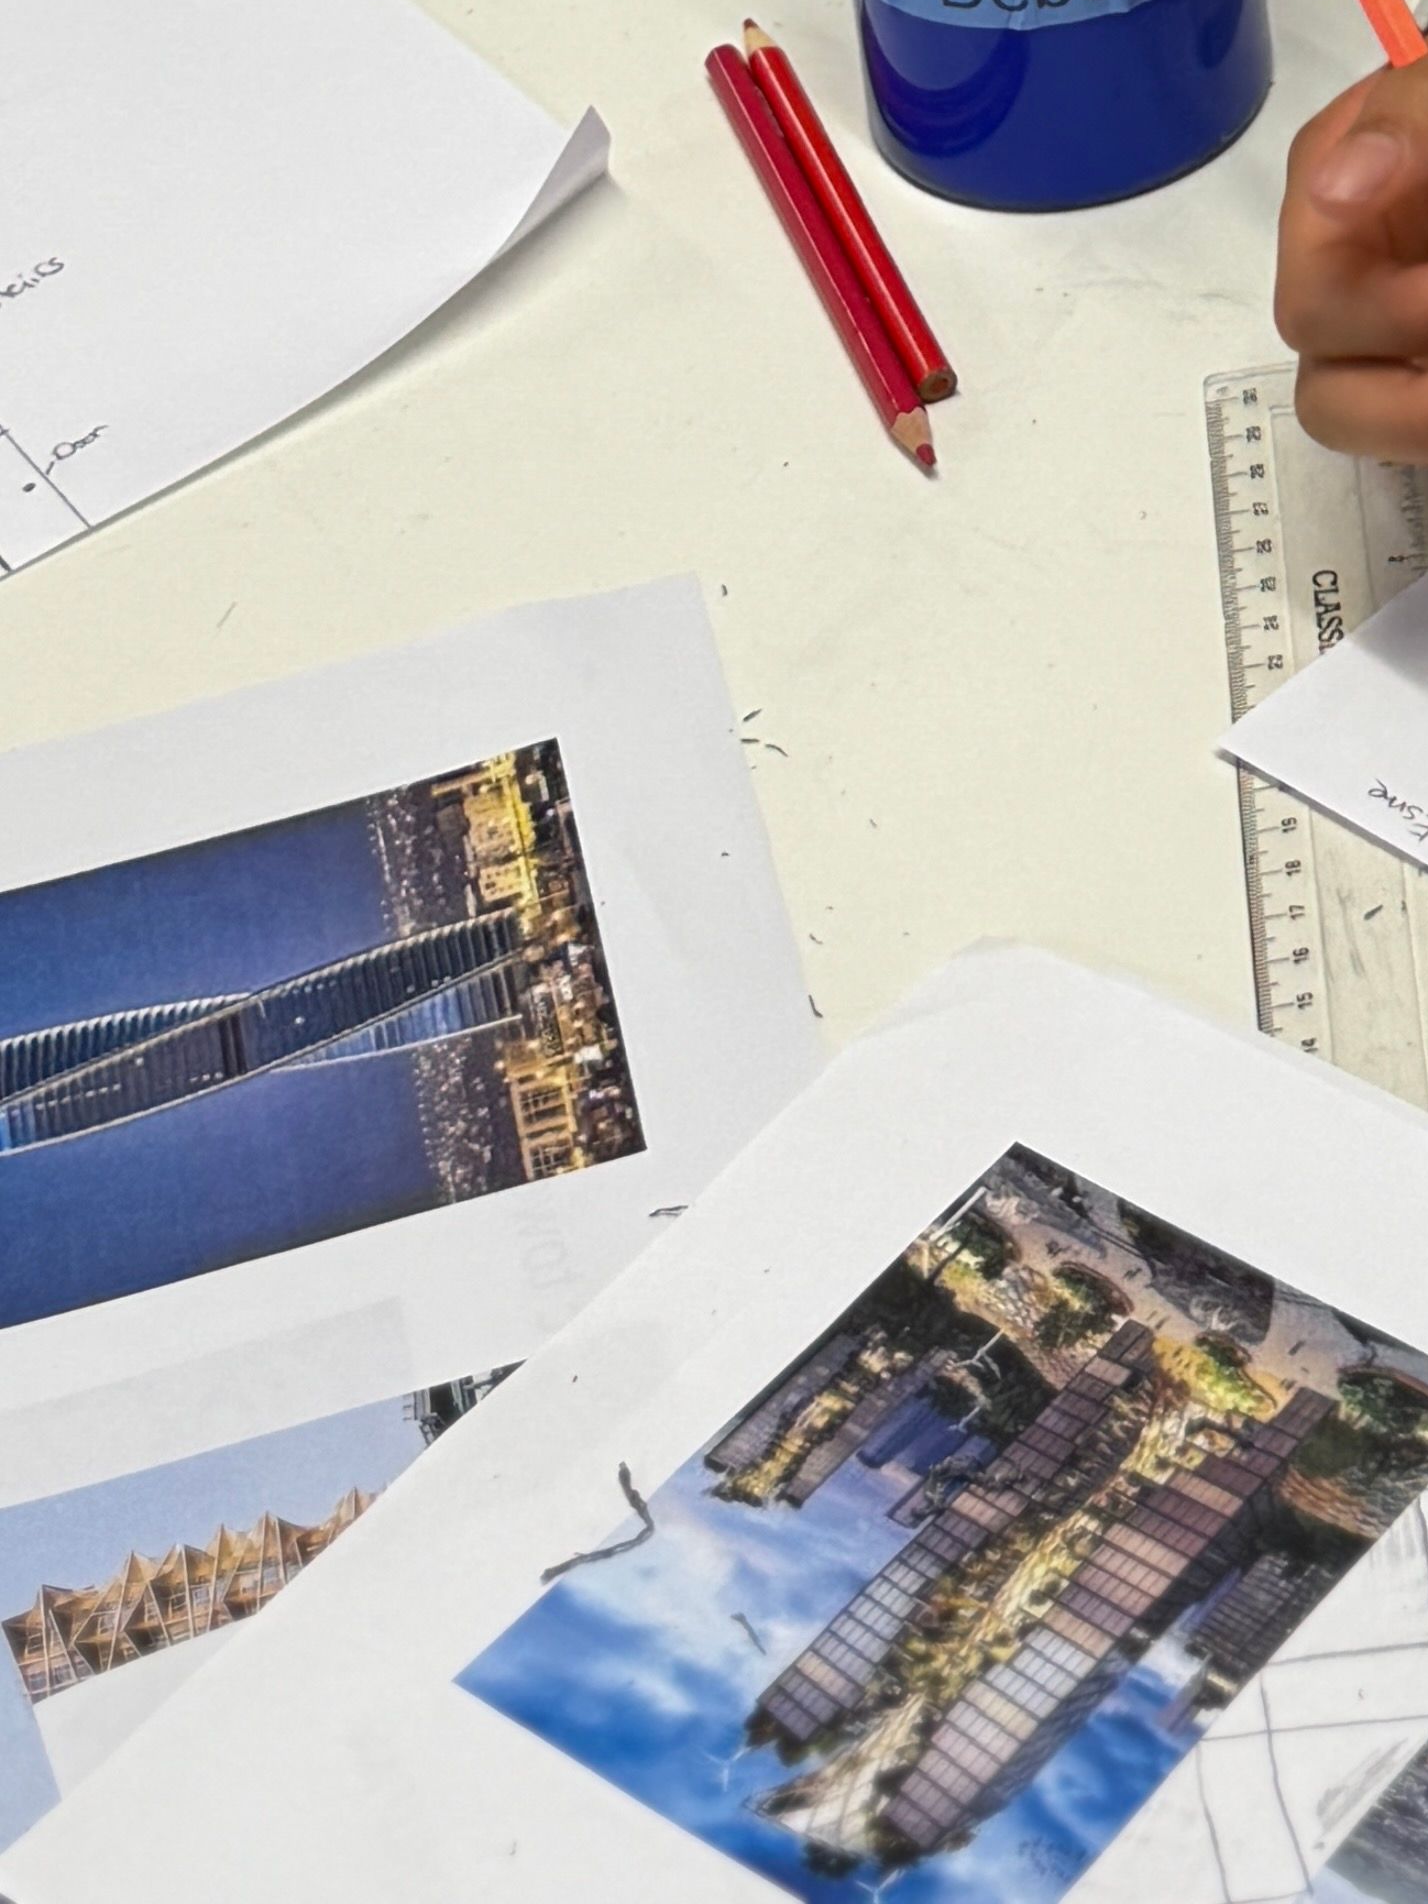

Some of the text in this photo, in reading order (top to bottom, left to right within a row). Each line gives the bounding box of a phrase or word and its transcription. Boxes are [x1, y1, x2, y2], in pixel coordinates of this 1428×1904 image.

[1312, 569, 1344, 653] CLASS
[1285, 860, 1301, 876] 18
[1288, 905, 1305, 920] 17
[1292, 947, 1309, 965] 16
[1296, 992, 1313, 1010] 15
